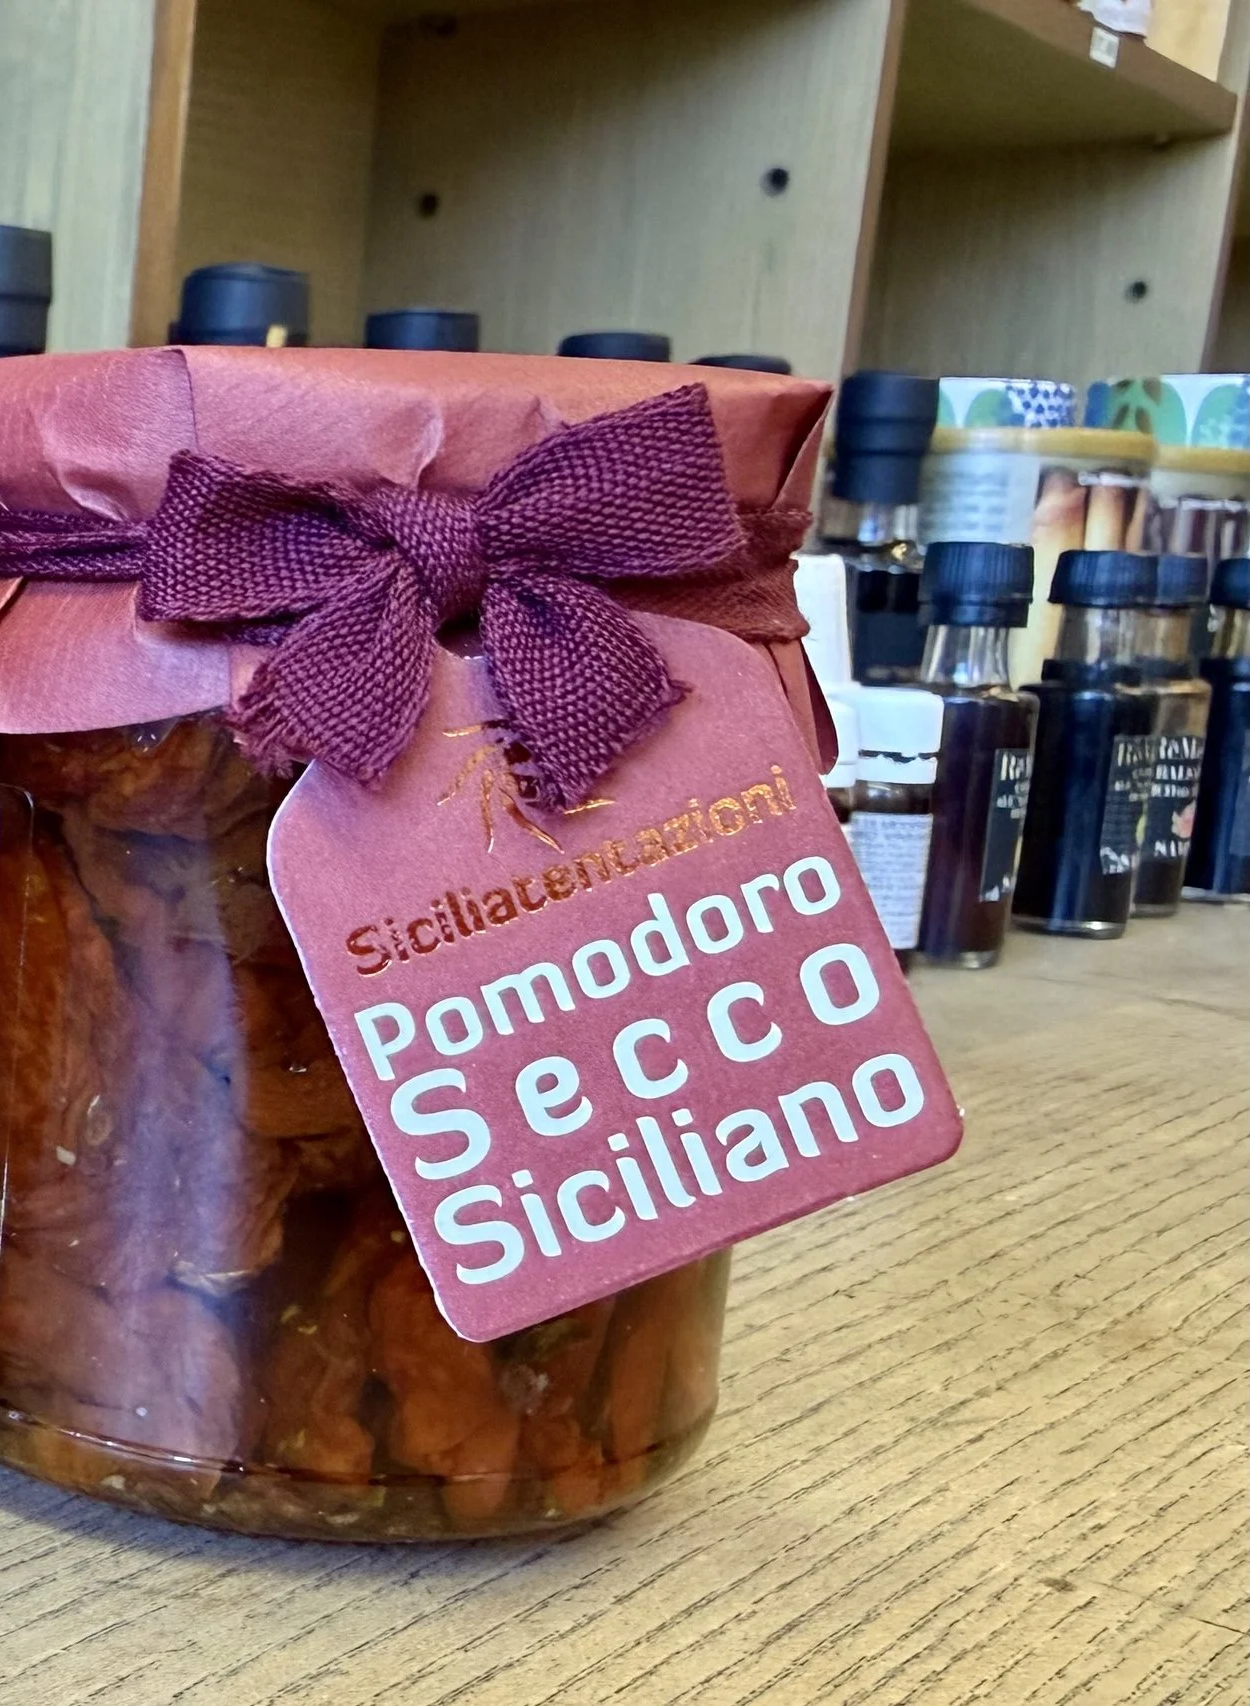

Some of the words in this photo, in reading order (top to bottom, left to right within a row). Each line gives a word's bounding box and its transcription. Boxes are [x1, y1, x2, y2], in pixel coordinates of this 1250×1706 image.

[347, 764, 799, 979] Siciliatentazioni
[353, 854, 842, 1082] Pomodoro
[389, 942, 881, 1182] Secco
[432, 1052, 926, 1287] Siciliano
